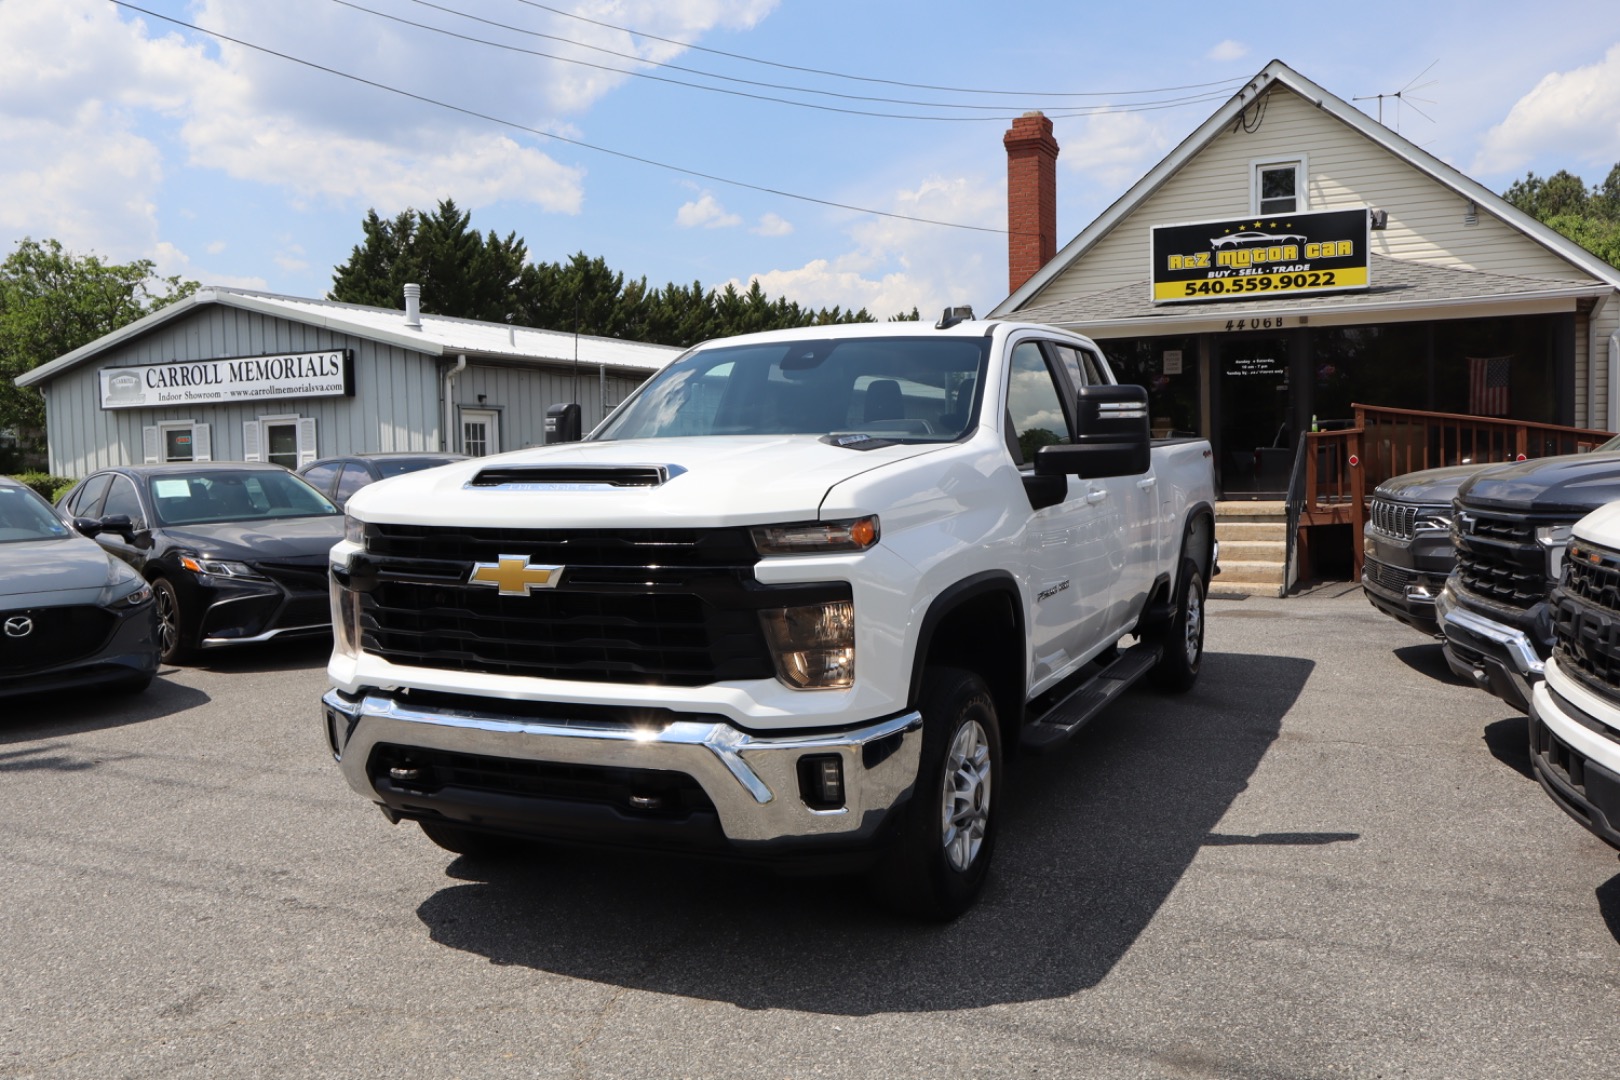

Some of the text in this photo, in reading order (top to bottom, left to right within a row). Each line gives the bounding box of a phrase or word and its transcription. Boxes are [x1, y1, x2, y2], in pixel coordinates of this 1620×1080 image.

[1168, 252, 1211, 271] R&Z
[1207, 263, 1310, 279] BUY SELL TRADE
[1185, 272, 1336, 296] 540.559.9022
[146, 354, 339, 388] CARROLL MEMORIALS
[158, 392, 182, 402] Indoor
[184, 390, 221, 400] Showroom
[230, 383, 342, 396] www.carrollmemorialsva.com
